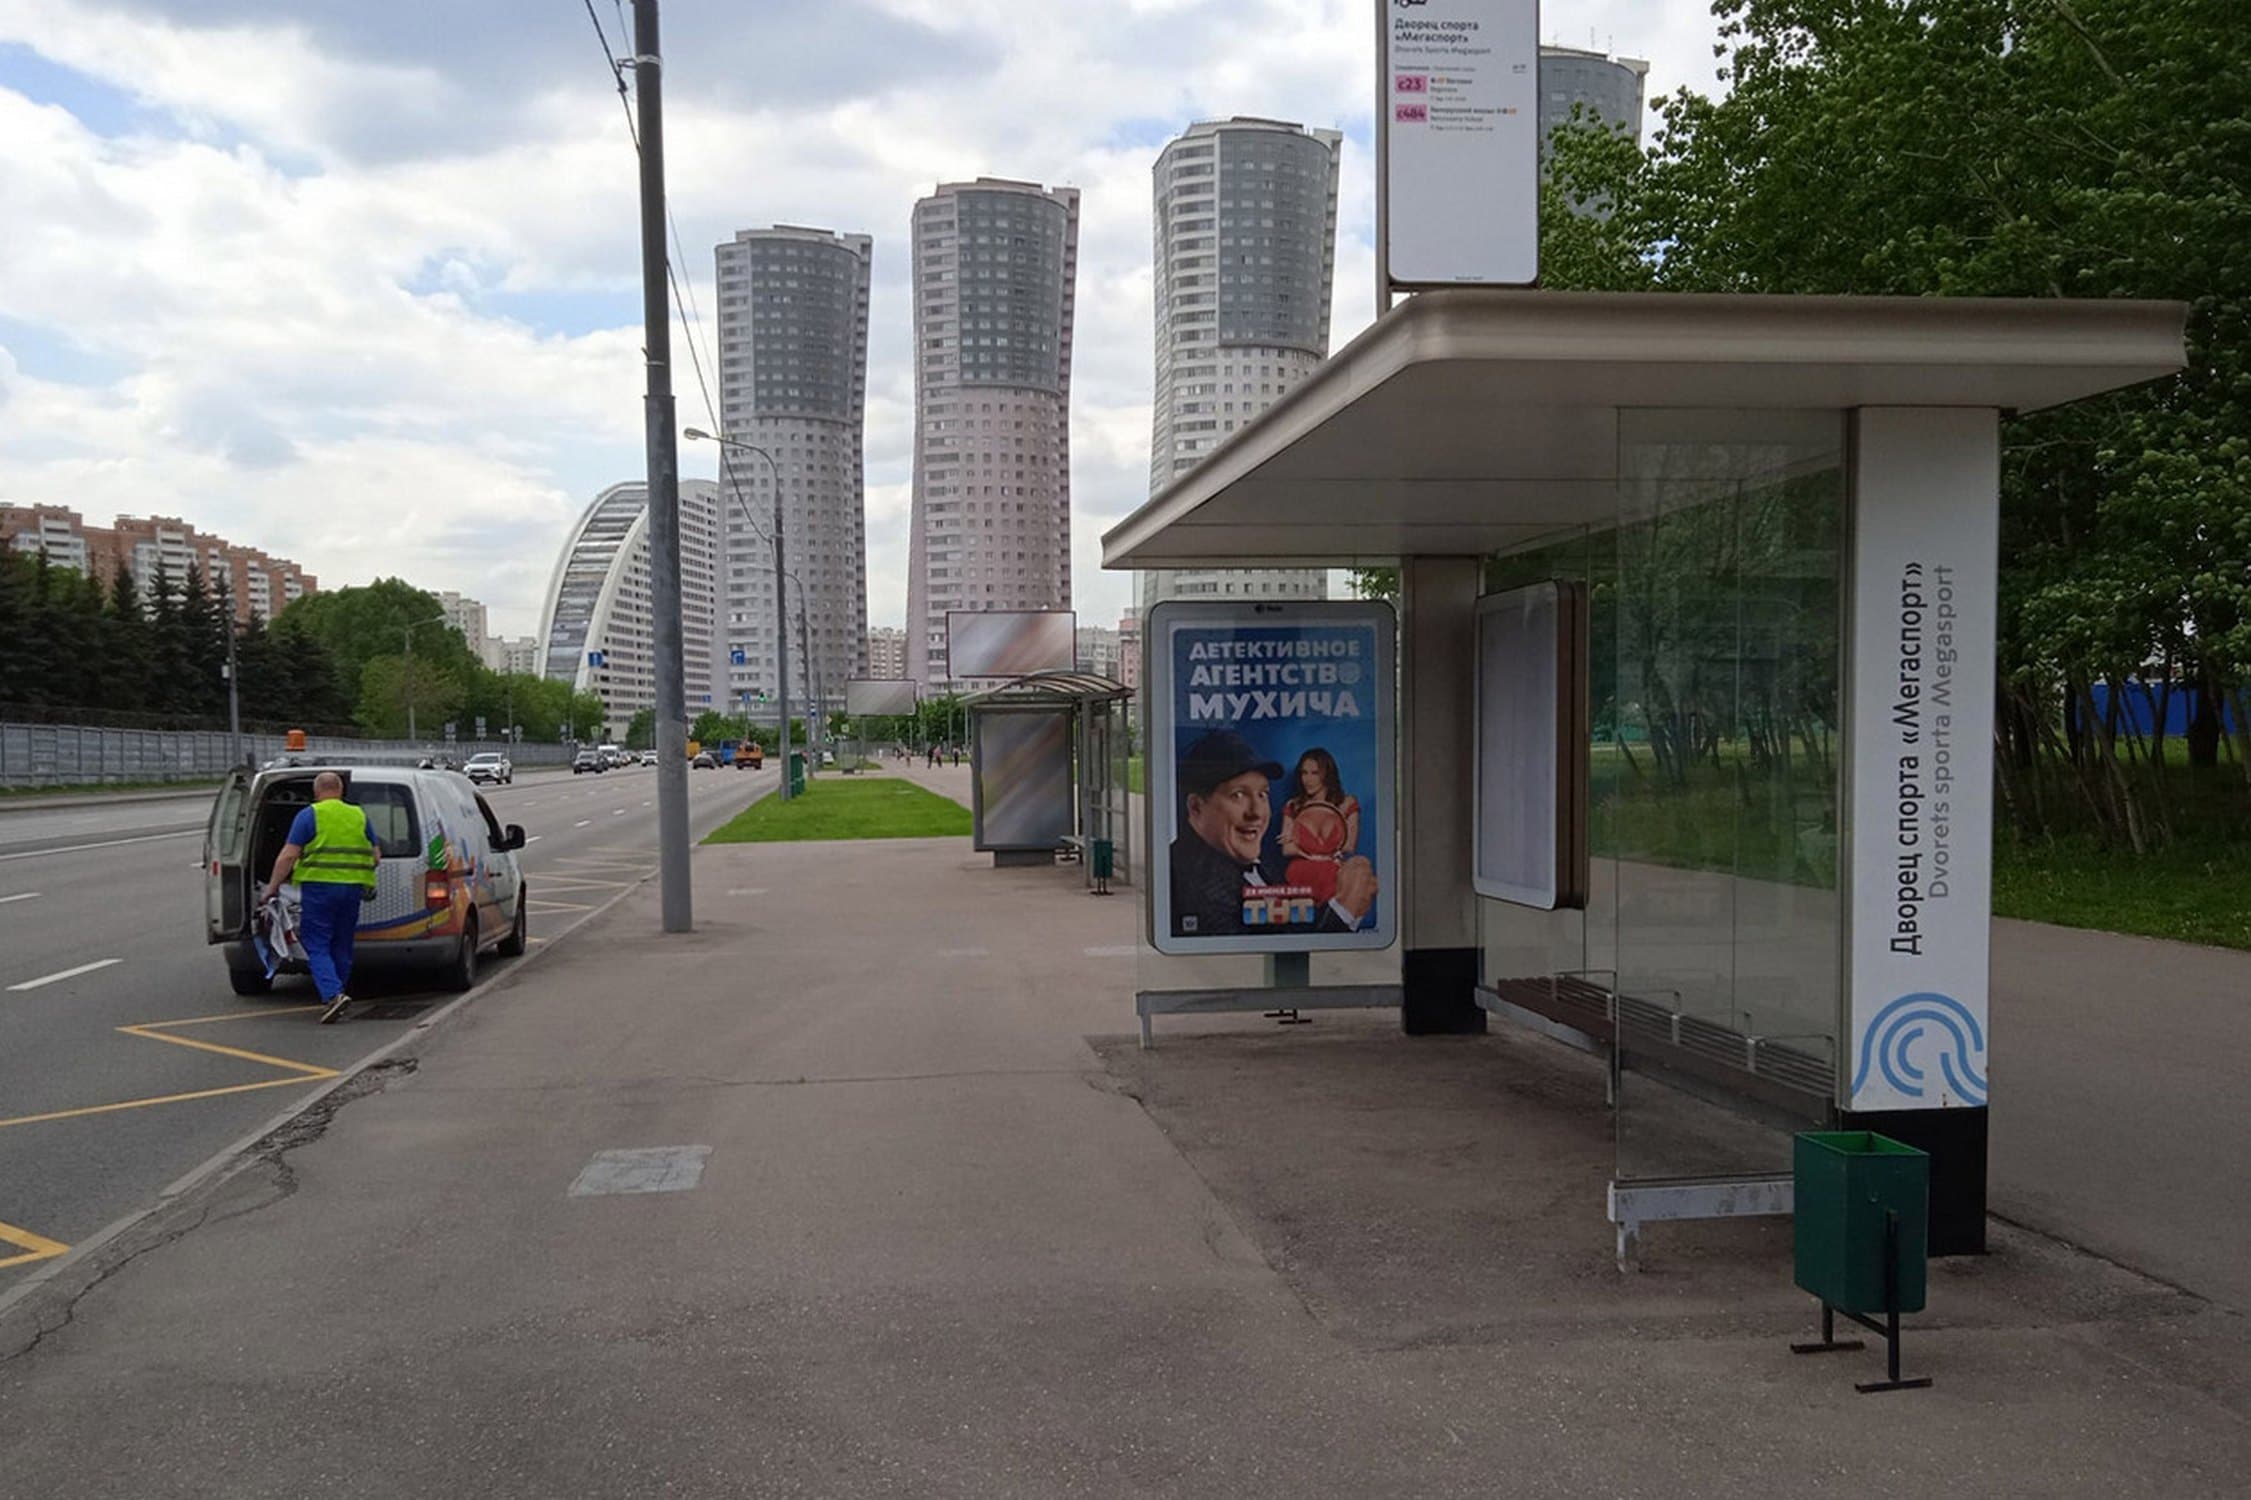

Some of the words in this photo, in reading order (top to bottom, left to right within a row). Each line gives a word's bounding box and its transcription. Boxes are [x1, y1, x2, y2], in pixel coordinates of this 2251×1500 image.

[1395, 18, 1438, 31] Дворец
[1440, 20, 1479, 31] спорта
[1395, 32, 1469, 44] «Мегаспорт»
[1397, 78, 1422, 91] с23
[1189, 640, 1361, 661] ДЕТЕКТИВНОЕ
[1931, 565, 1958, 706] Megasport
[1893, 561, 1928, 744] «Мегаспорт»
[1190, 662, 1362, 686] АГЕНТСТВО
[1190, 690, 1361, 720] МУХИЧА
[1930, 716, 1954, 795] sporta
[1899, 756, 1925, 846] спорта
[1929, 802, 1950, 898] Dvorets
[1243, 899, 1315, 925] ТНТ
[1890, 852, 1925, 956] Дворец
